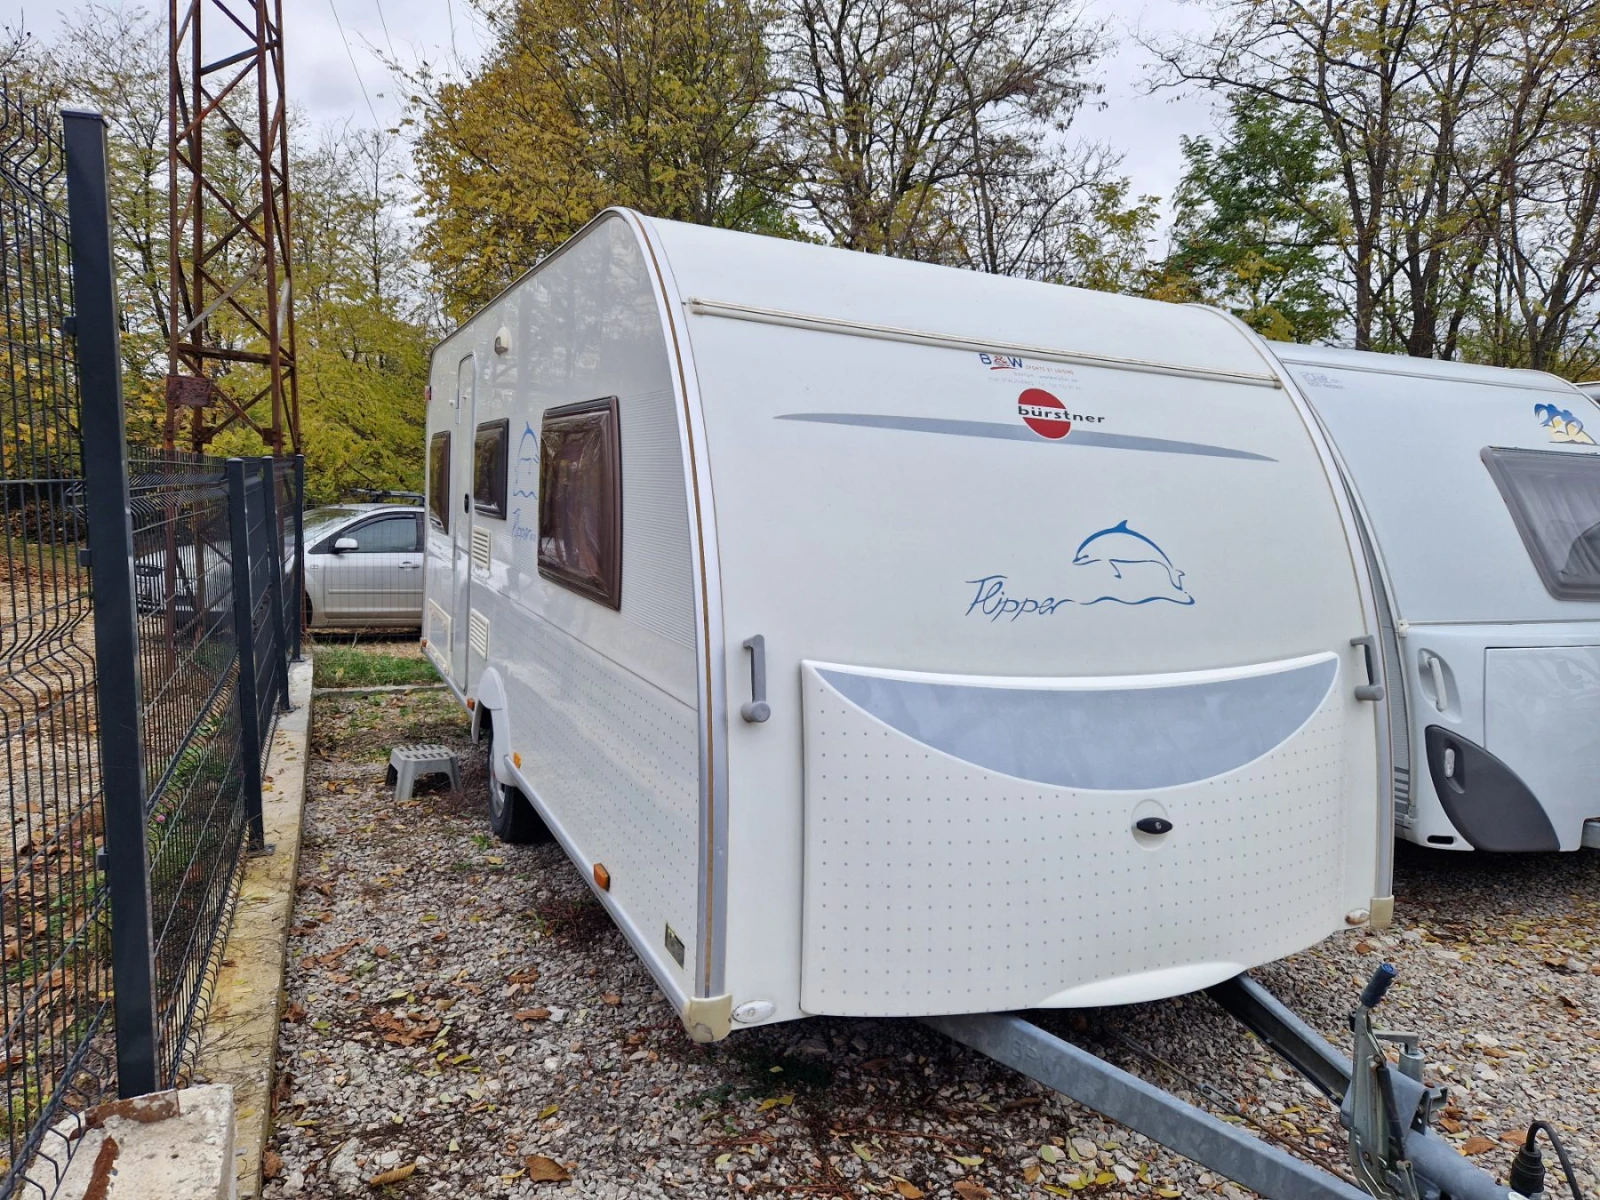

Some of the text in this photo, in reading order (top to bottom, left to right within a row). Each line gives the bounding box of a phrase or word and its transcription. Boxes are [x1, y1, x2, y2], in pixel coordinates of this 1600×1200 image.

[978, 353, 1023, 369] B&W
[1018, 405, 1105, 424] bürstner
[965, 575, 1075, 623] Flipper
